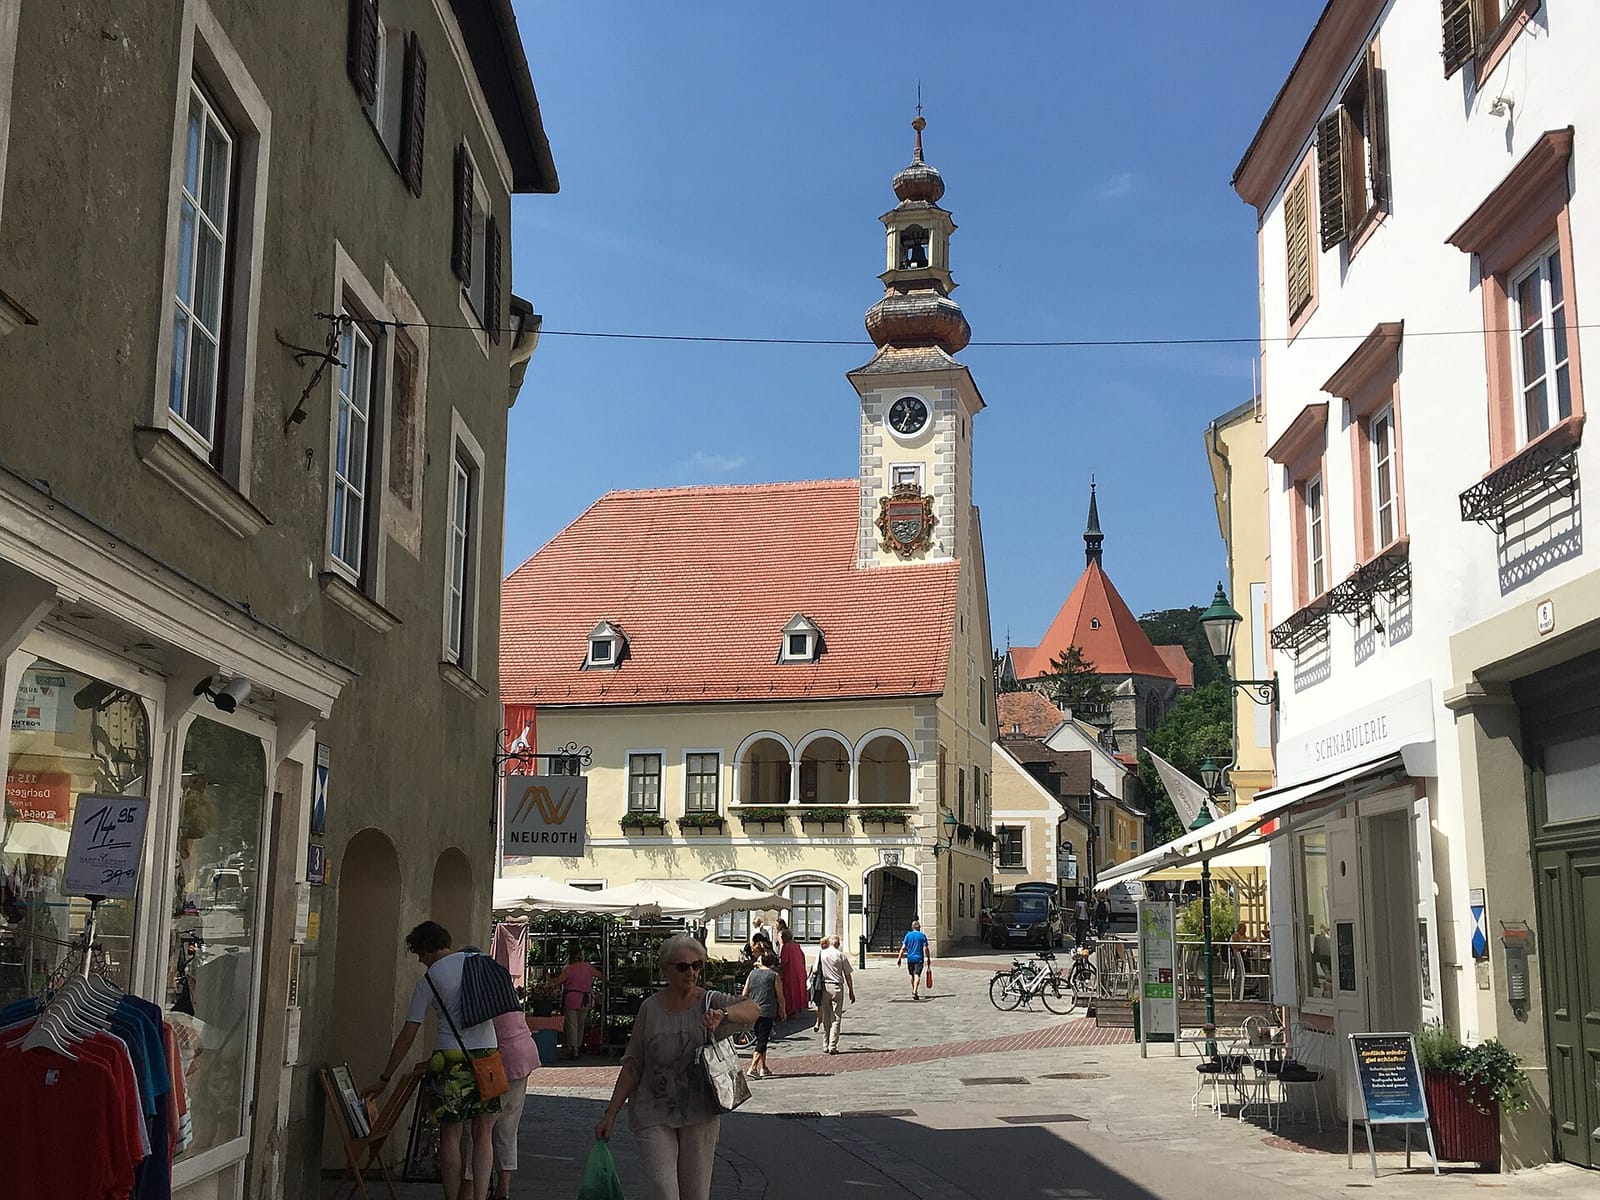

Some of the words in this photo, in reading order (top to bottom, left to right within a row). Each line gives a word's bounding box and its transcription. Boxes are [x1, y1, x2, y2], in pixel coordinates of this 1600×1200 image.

[1542, 606, 1548, 620] 6
[1315, 714, 1388, 762] SCHNABULERIE
[510, 831, 578, 844] NEUROTH
[314, 847, 320, 871] 3
